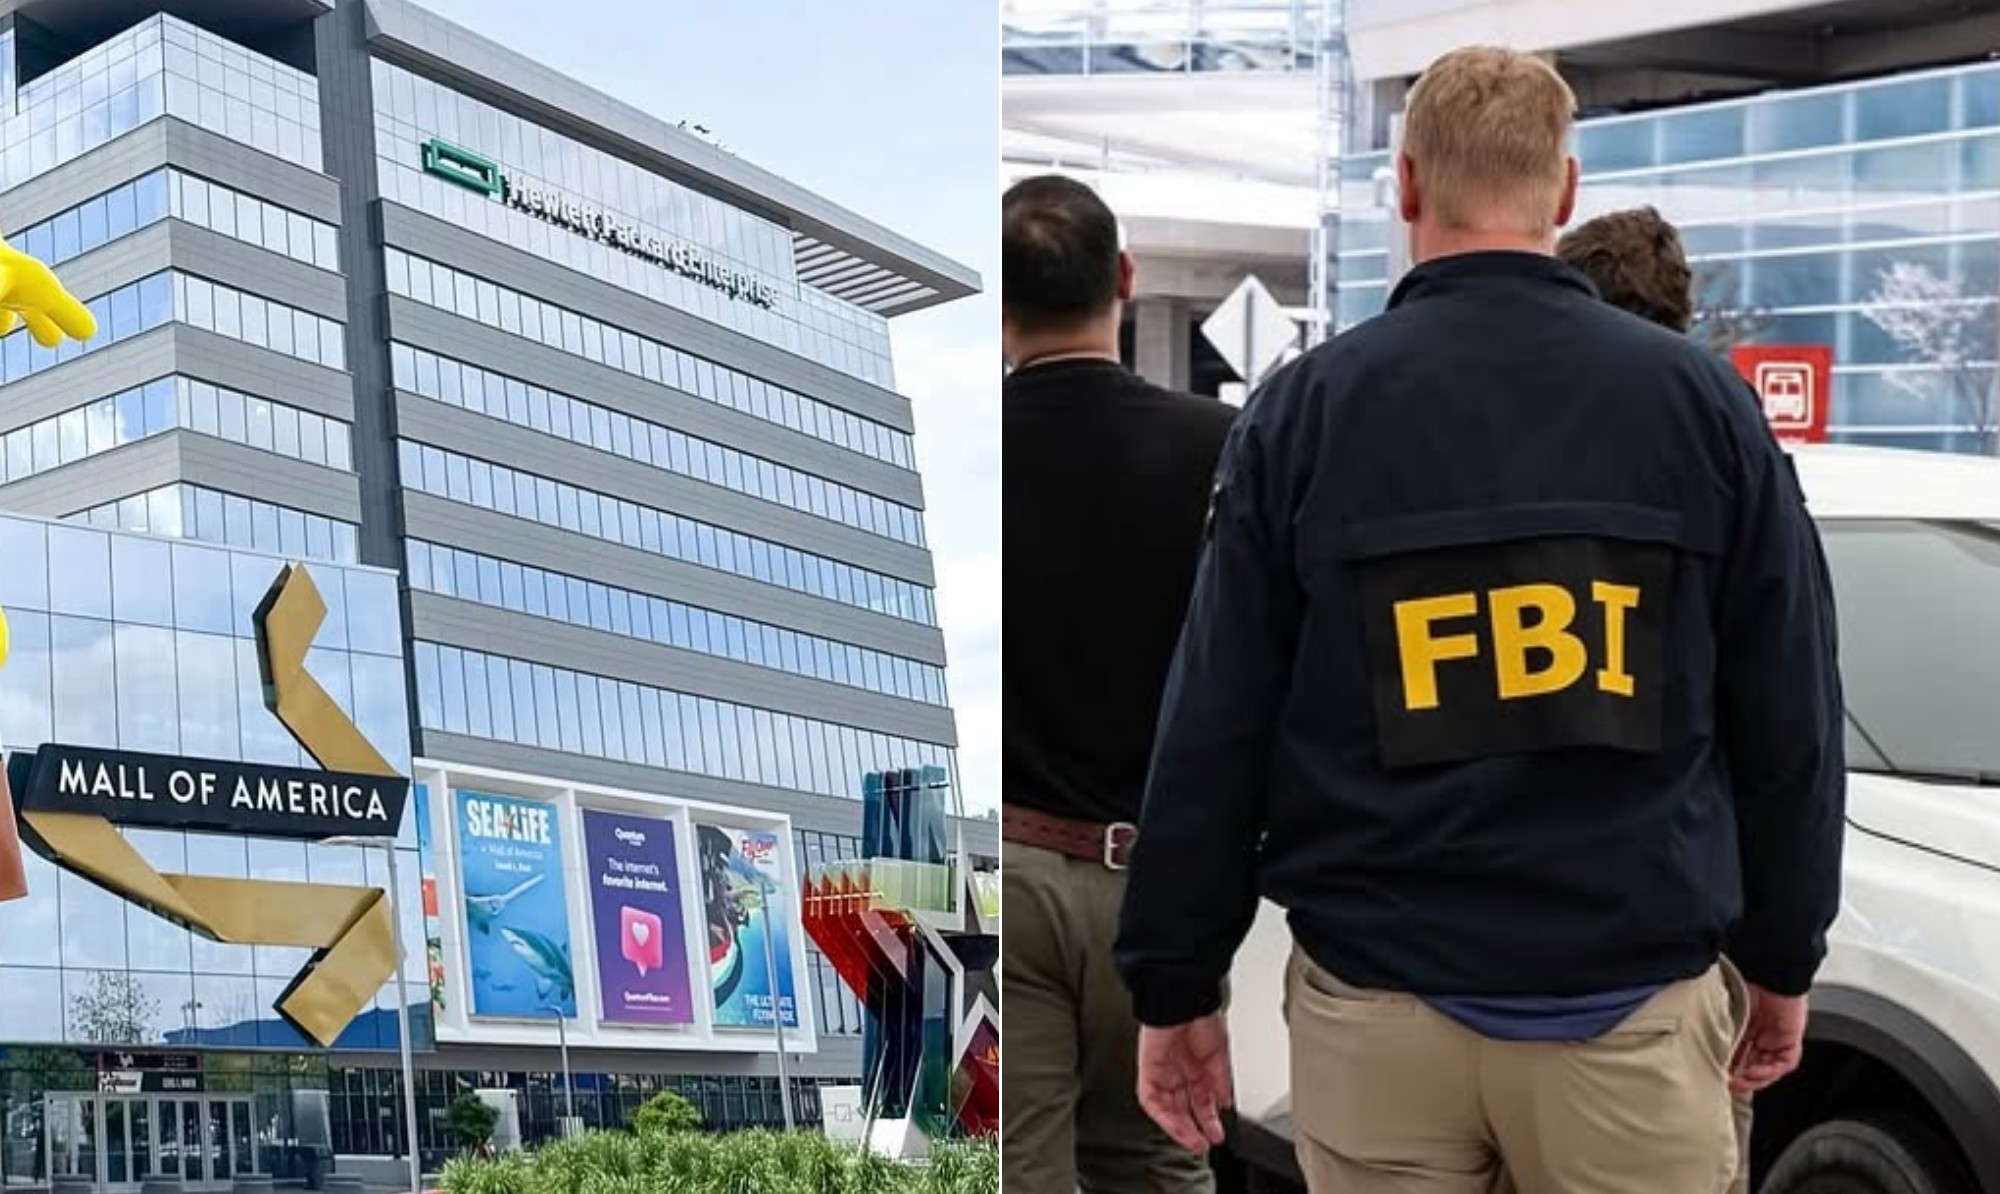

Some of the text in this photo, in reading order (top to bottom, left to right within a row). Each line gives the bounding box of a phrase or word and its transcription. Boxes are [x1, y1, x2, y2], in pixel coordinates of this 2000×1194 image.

[505, 172, 781, 306] Hewlett Packard Enterprise
[1393, 579, 1640, 710] FBI
[58, 759, 389, 821] MALL OF AMERICA
